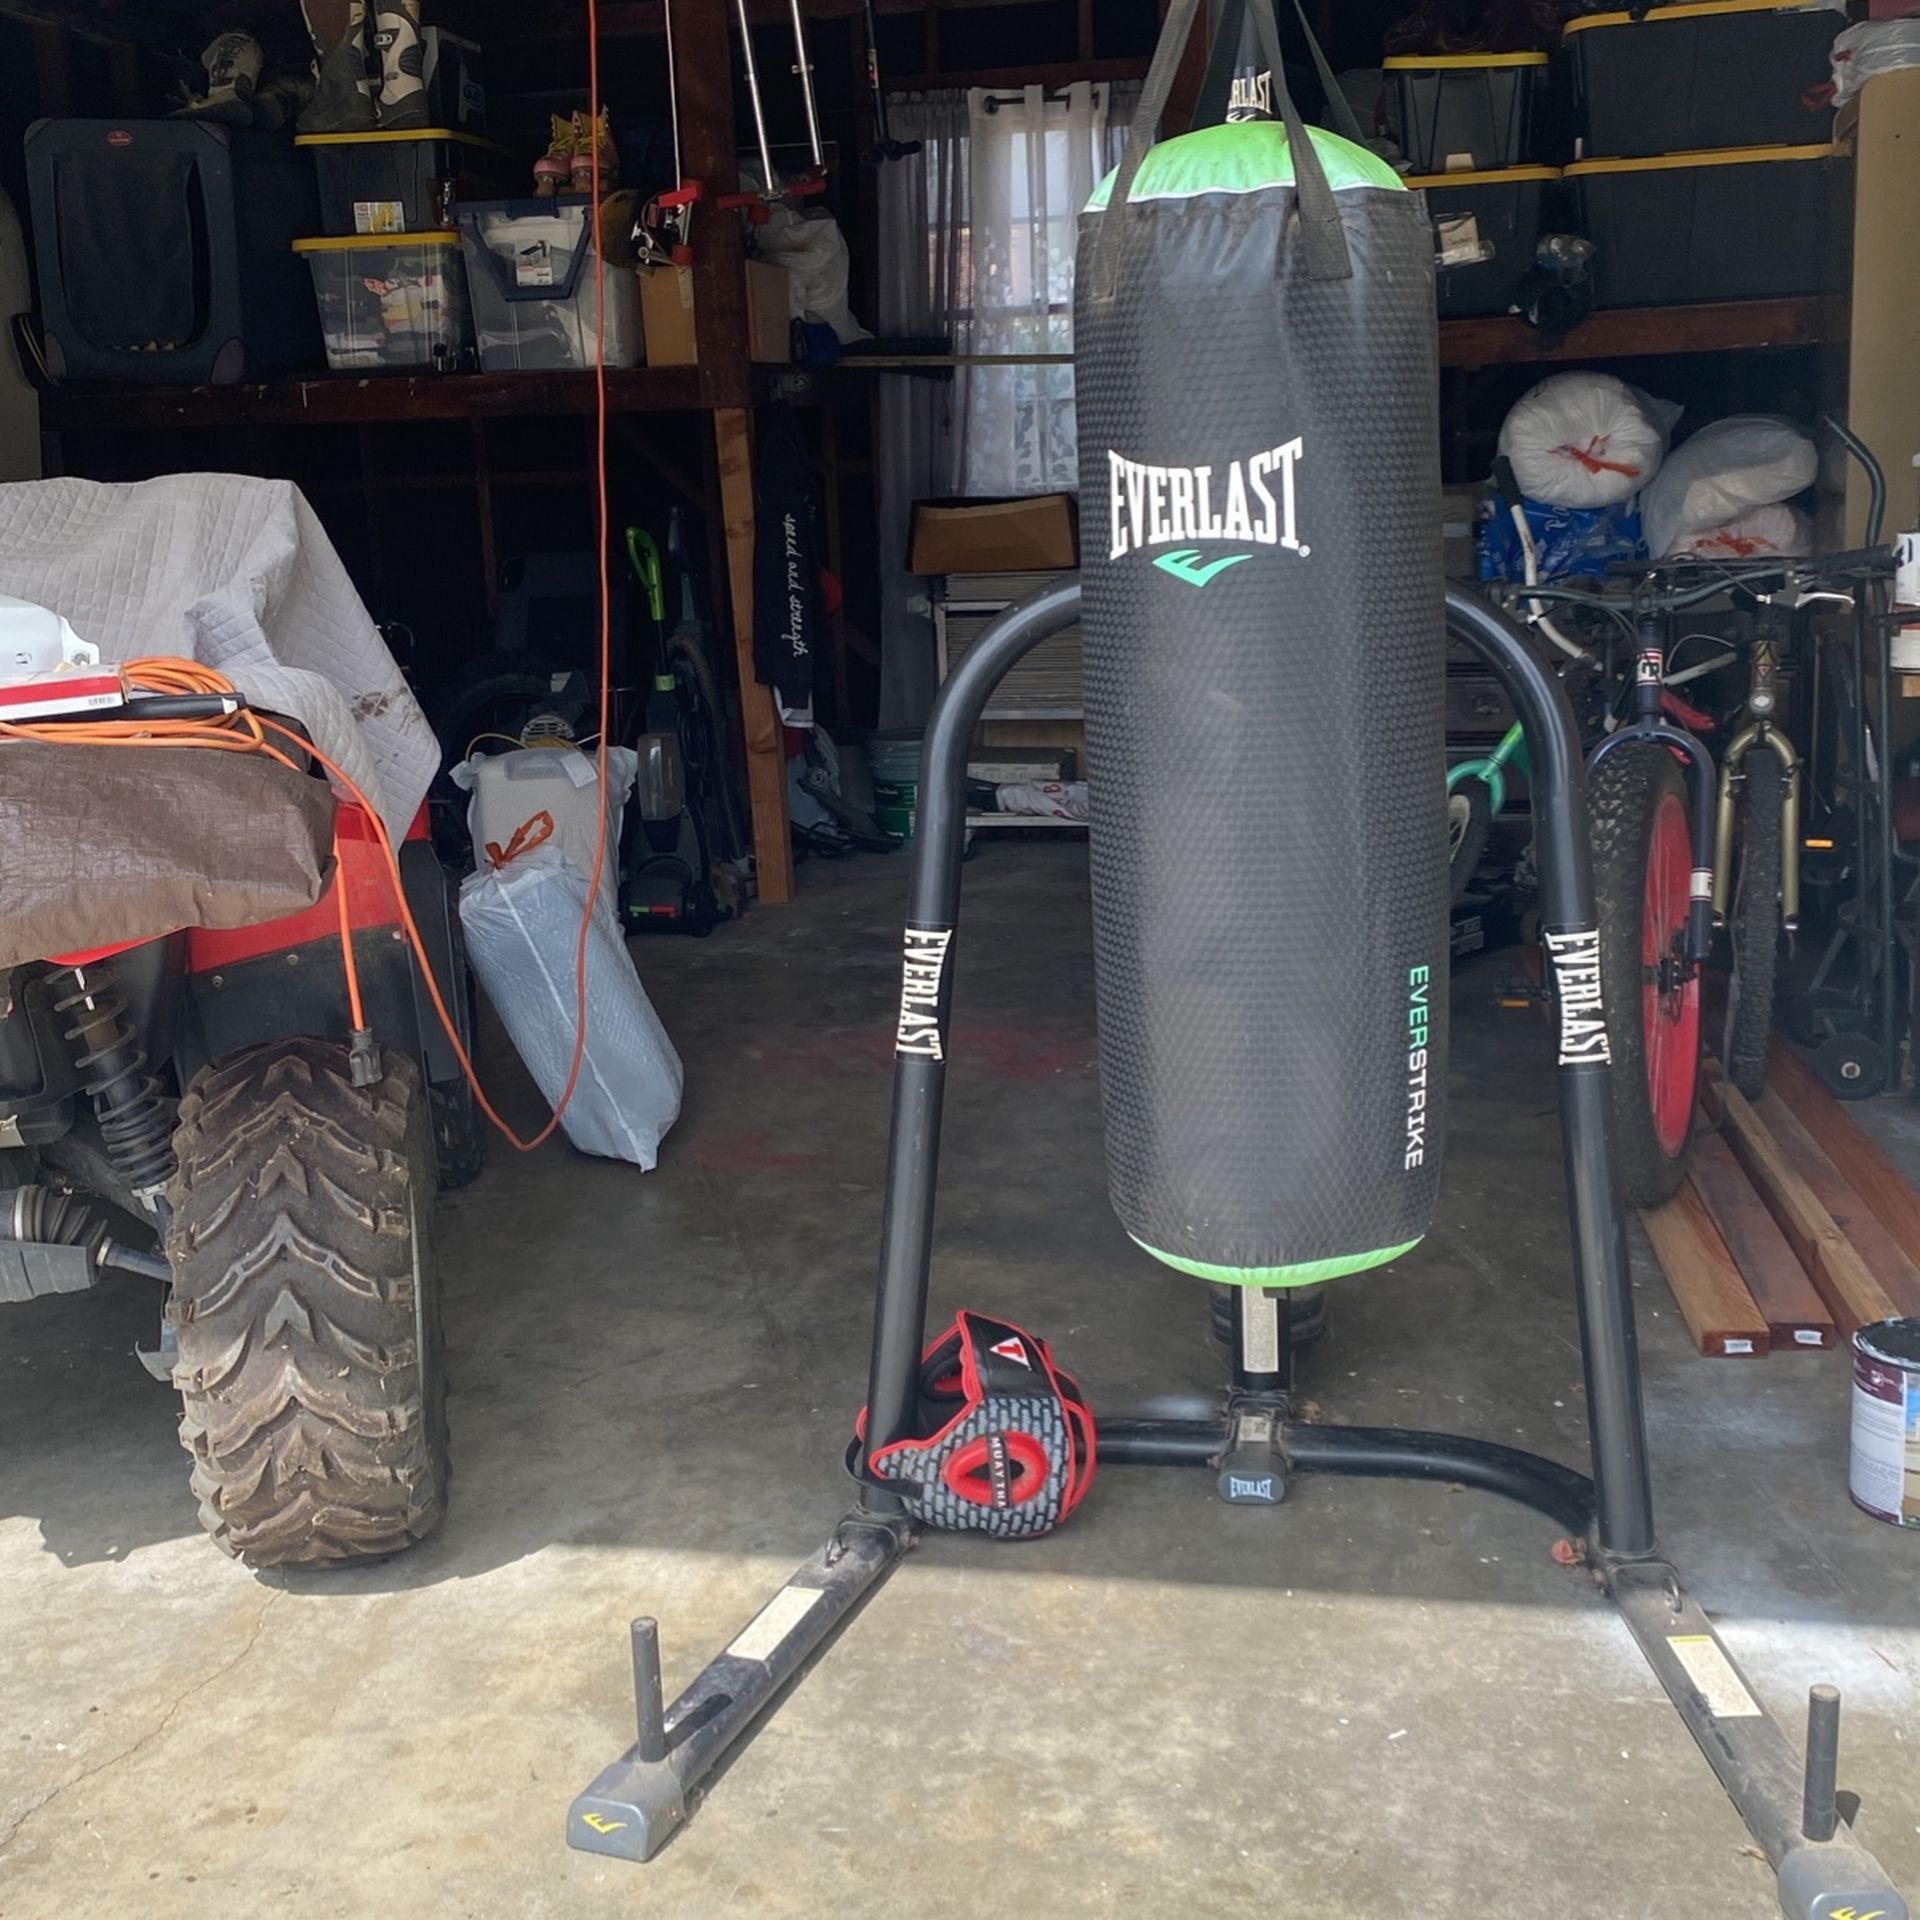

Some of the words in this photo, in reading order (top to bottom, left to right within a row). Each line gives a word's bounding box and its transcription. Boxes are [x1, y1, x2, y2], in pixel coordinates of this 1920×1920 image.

[1228, 70, 1273, 115] RLAST
[1108, 436, 1303, 560] EVERLAST
[782, 513, 803, 558] speed
[788, 561, 805, 591] and
[781, 594, 809, 658] strength
[895, 929, 952, 1060] EVERLAST
[1545, 928, 1611, 1066] EVERLAST
[1405, 965, 1430, 1171] EVERSTRIKE
[991, 1437, 1005, 1478] MUAY
